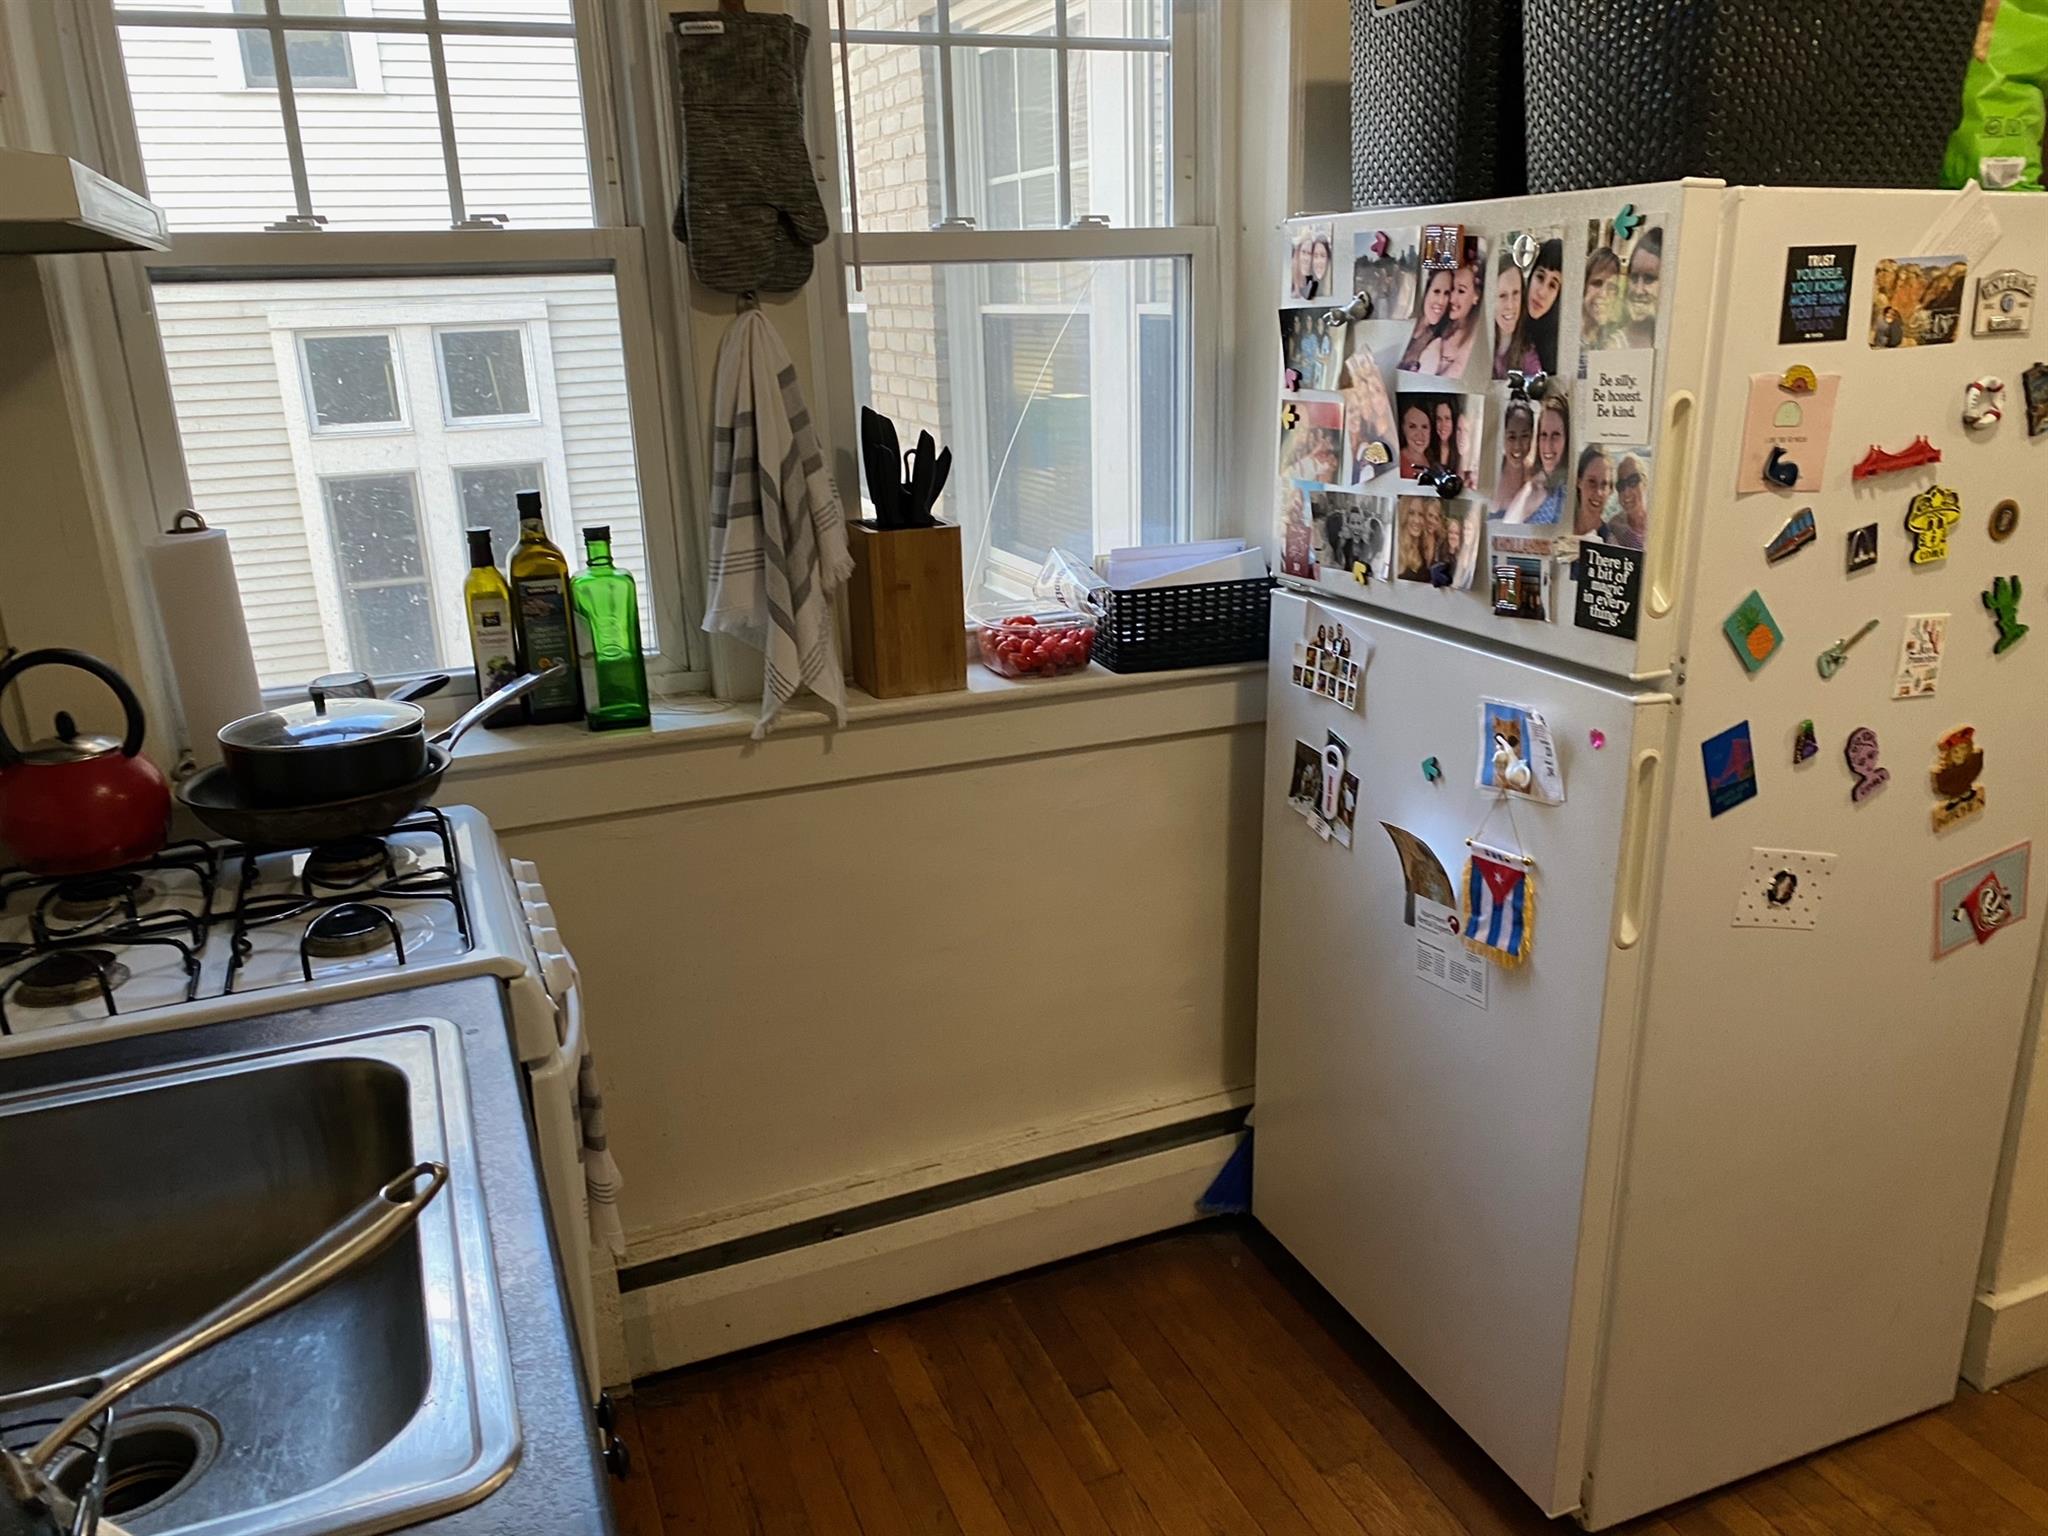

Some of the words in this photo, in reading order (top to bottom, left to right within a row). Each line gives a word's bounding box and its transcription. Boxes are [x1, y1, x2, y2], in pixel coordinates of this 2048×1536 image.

[1807, 254, 1836, 267] TRUST
[1791, 281, 1814, 293] YOU
[1599, 372, 1613, 387] Be
[1592, 388, 1606, 402] Be
[1596, 404, 1610, 417] Be
[1586, 548, 1622, 570] There
[1623, 557, 1635, 573] is
[1587, 567, 1596, 578] a
[1597, 565, 1613, 582] bit
[1614, 570, 1631, 585] of
[1590, 580, 1625, 599] magic
[1583, 589, 1595, 604] in
[1596, 595, 1631, 615] every
[1589, 604, 1622, 627] thing.
